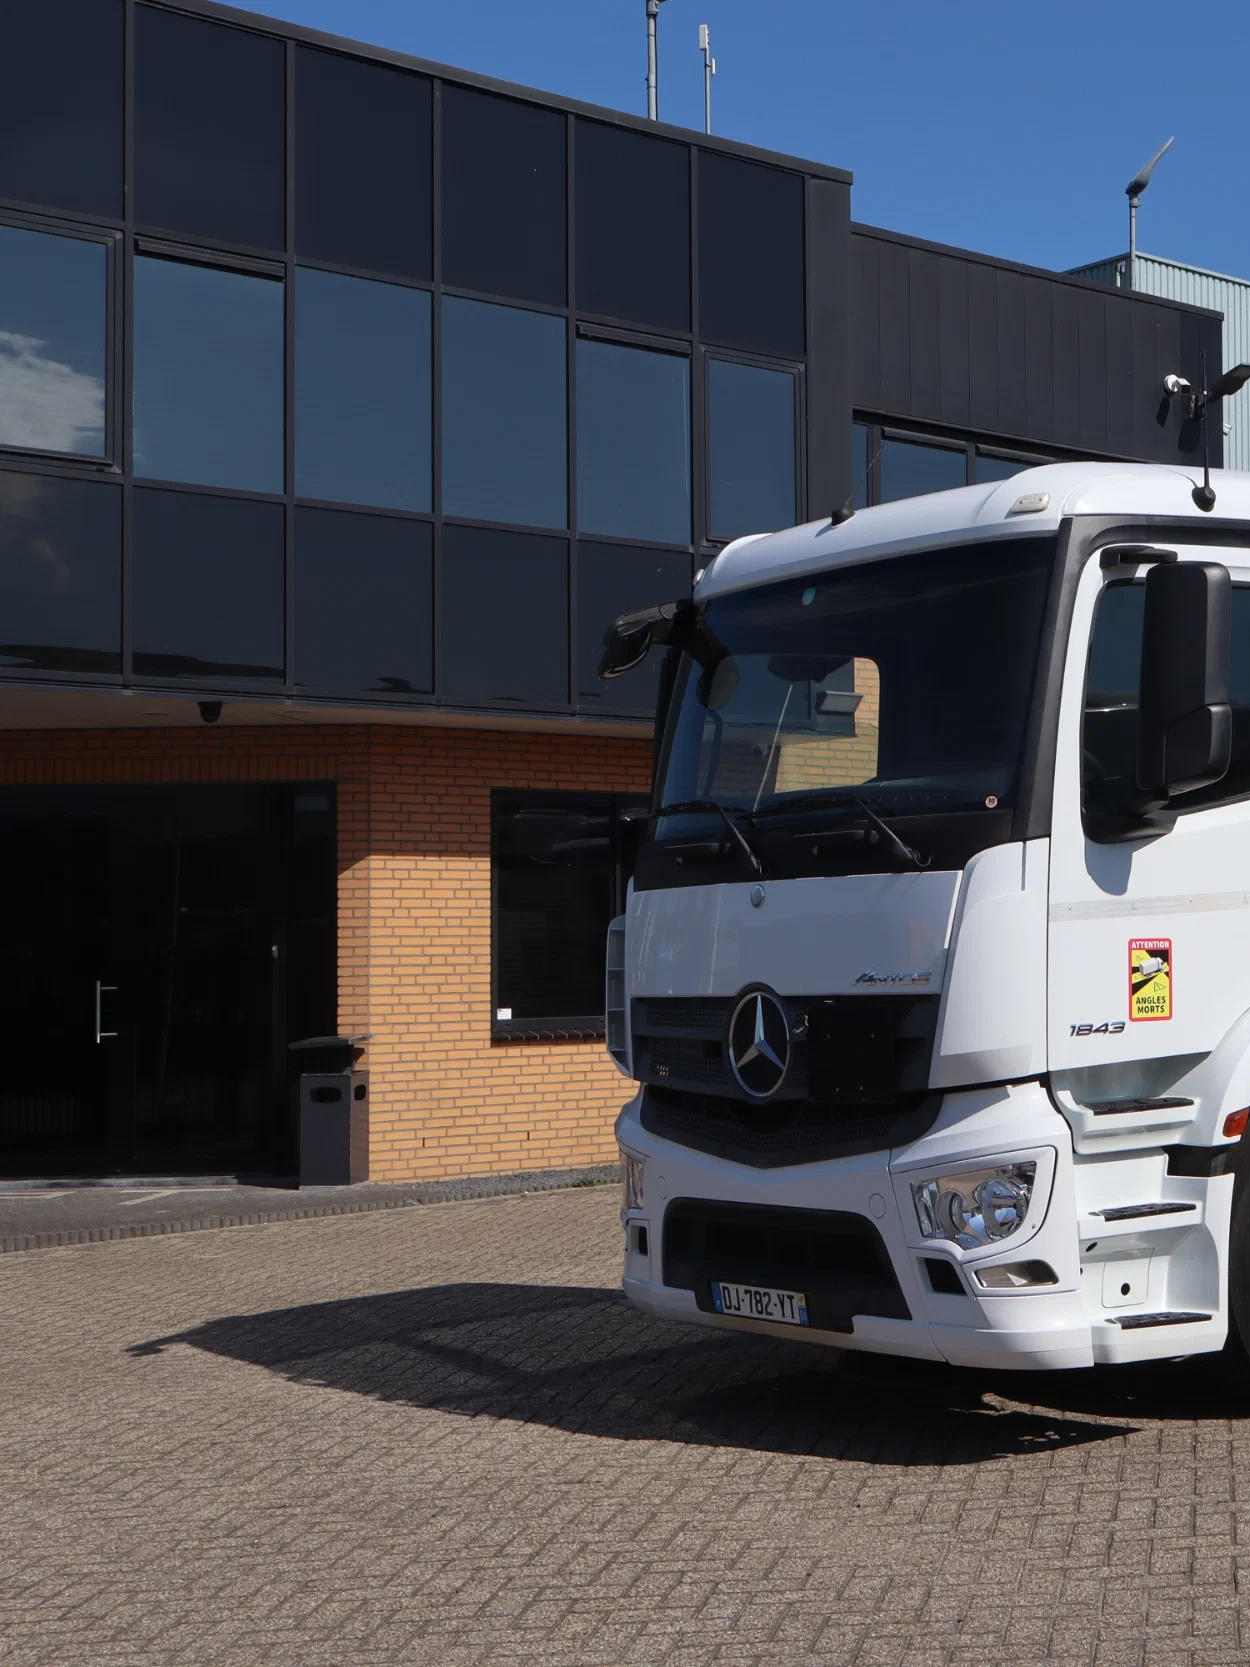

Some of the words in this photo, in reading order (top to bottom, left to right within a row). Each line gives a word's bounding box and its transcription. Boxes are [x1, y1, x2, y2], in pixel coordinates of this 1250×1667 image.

[1131, 941, 1169, 949] ATTENTION
[1135, 996, 1166, 1005] ANGLES
[1137, 1005, 1165, 1014] MORTS
[1069, 1020, 1126, 1037] 1843
